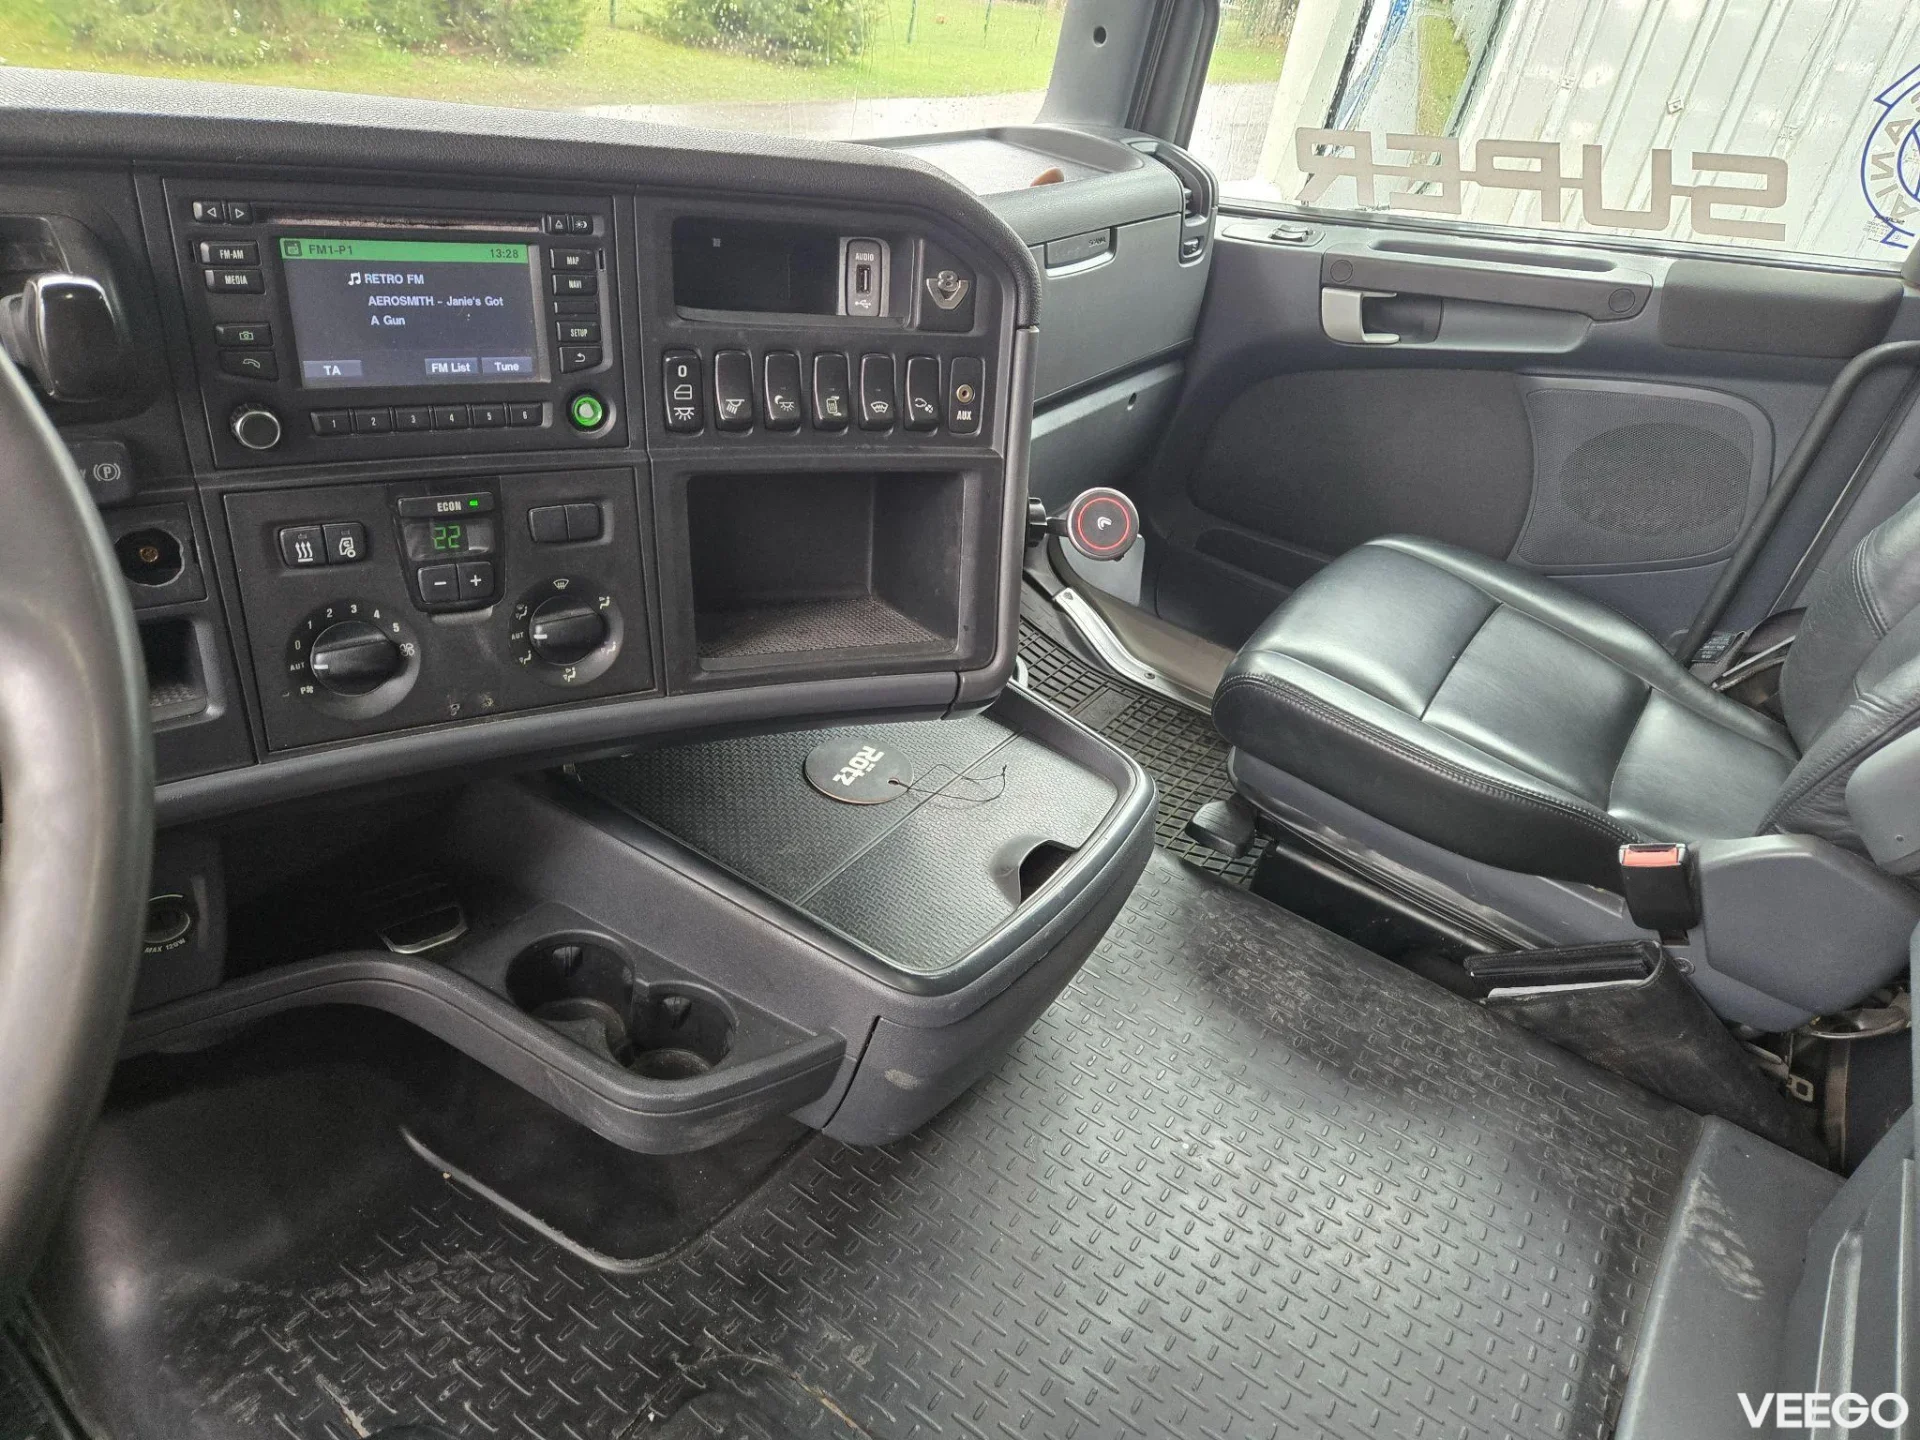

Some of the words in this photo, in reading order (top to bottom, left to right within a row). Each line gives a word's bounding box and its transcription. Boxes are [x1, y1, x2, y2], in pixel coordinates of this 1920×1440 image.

[219, 249, 244, 260] FM-AM
[308, 244, 353, 255] FM1-P1
[489, 248, 519, 259] 13:28
[566, 256, 580, 265] MAP
[855, 252, 875, 262] AUDIO
[224, 274, 248, 286] MEDIA
[364, 273, 404, 285] RETRO
[407, 273, 425, 285] FM
[367, 296, 434, 307] AEROSMITH
[446, 296, 481, 307] Janie's
[484, 296, 504, 307] Got
[370, 315, 380, 326] A
[383, 315, 405, 326] Gun
[570, 328, 588, 338] SETUP
[323, 365, 342, 376] TA
[431, 362, 450, 373] FM
[451, 361, 471, 373] List
[494, 361, 520, 372] Tune
[410, 414, 416, 424] 3
[449, 413, 455, 423] 4
[486, 412, 492, 421] 5
[522, 411, 528, 420] 6
[956, 409, 972, 421] AUX
[331, 419, 336, 428] 1
[371, 417, 377, 426] 2
[437, 501, 462, 512] ECON
[433, 525, 461, 550] 22
[326, 608, 333, 618] 2
[350, 604, 357, 613] 3
[373, 609, 380, 619] 4
[392, 622, 400, 632] 5
[511, 631, 524, 640] AUT
[289, 661, 305, 671] AUT
[144, 945, 163, 953] MAX
[165, 937, 186, 950] 120W
